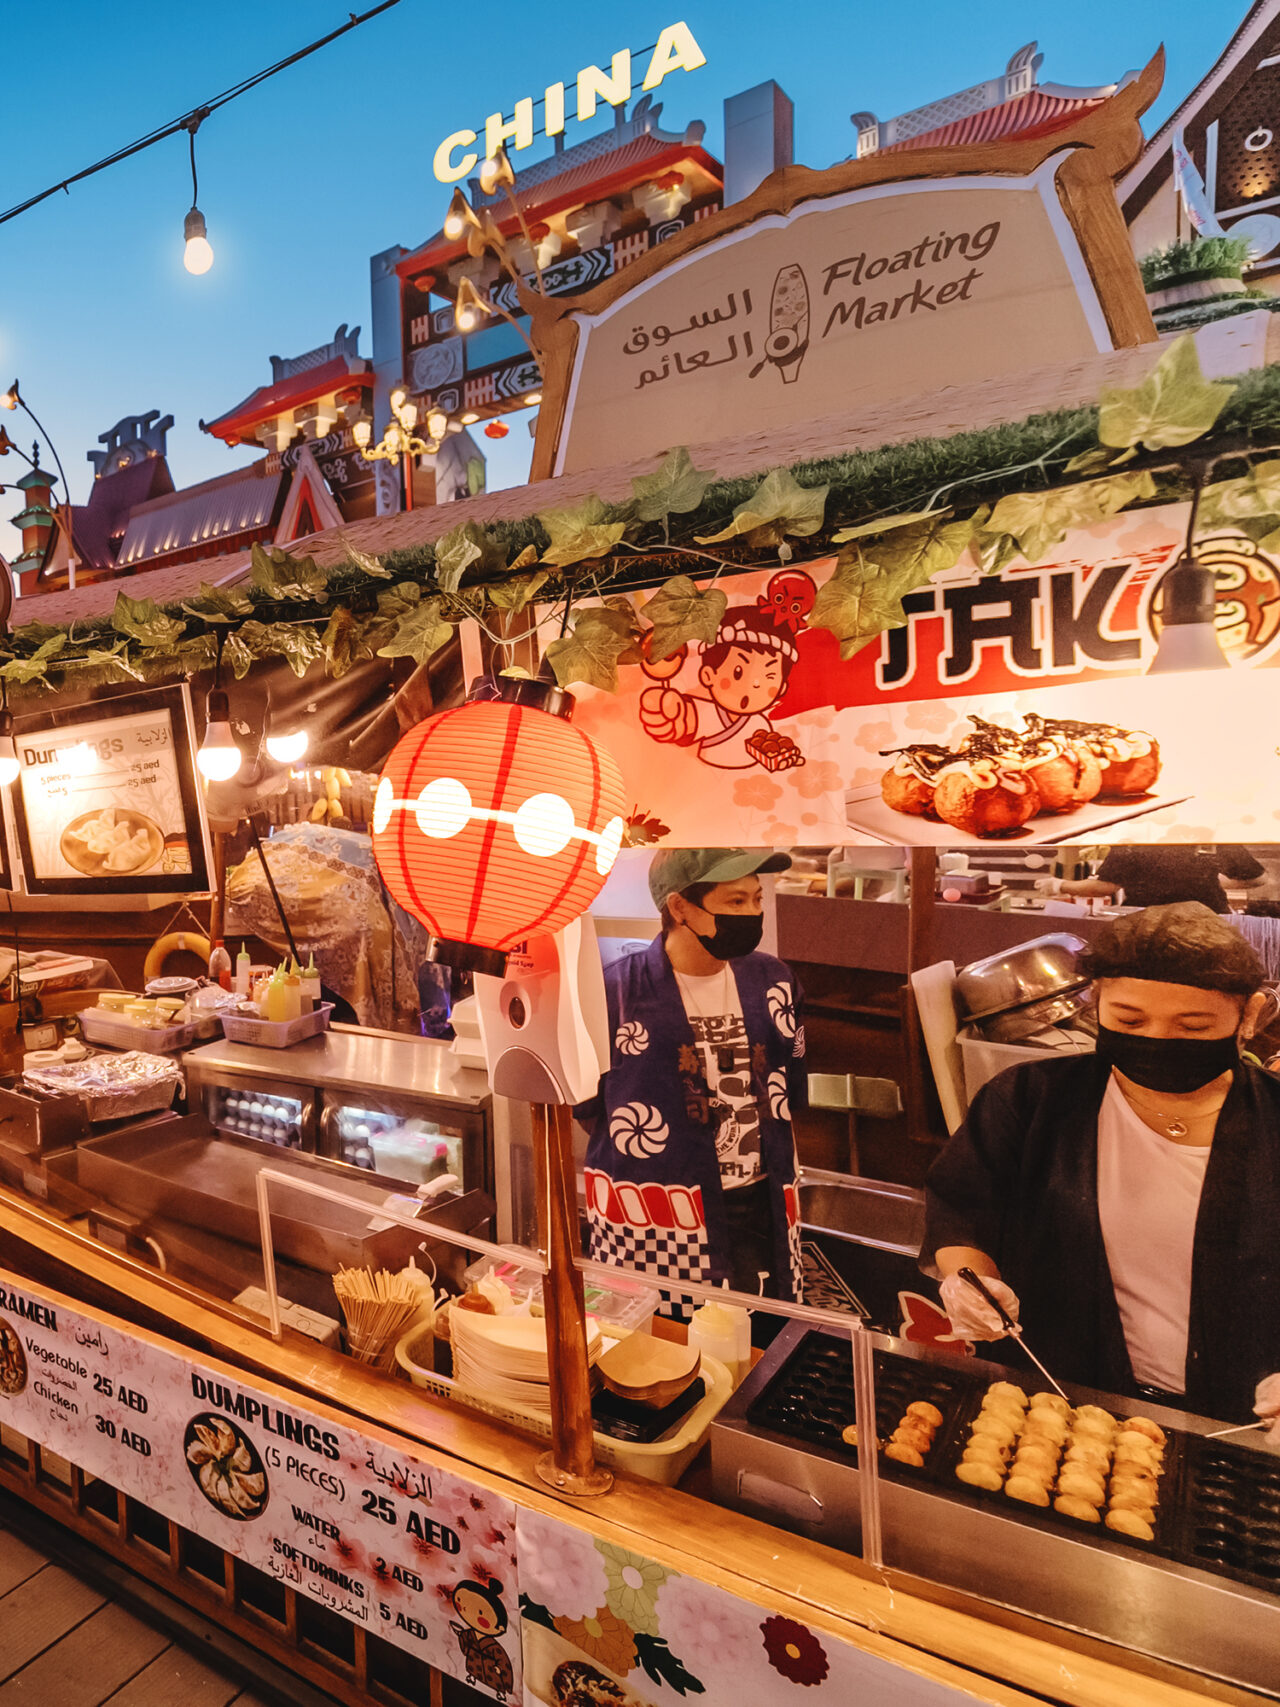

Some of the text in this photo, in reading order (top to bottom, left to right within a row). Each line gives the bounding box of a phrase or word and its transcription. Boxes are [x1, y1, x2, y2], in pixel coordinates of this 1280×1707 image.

[433, 21, 707, 183] CHINA
[822, 221, 1001, 296] Floating
[622, 288, 752, 355] السوق
[822, 268, 983, 338] Market
[634, 331, 753, 389] العائم
[140, 774, 157, 785] aed
[143, 759, 160, 769] aed
[716, 1141, 730, 1154] THE
[75, 1327, 109, 1356] رامين
[26, 1336, 148, 1414] Vegetable 25 AED
[34, 1381, 151, 1457] Chicken 30 AED
[192, 1372, 340, 1461] DUMPLINGS
[265, 1446, 346, 1501] (5 PIECES)
[365, 1451, 432, 1500] الزلابية
[291, 1504, 424, 1592] WATER 2 AED
[308, 1533, 326, 1551] ماء
[361, 1489, 460, 1554] 25 AED
[268, 1555, 368, 1621] المشروبات الغازية
[273, 1538, 428, 1640] SOFTDRINKS 5 AED
